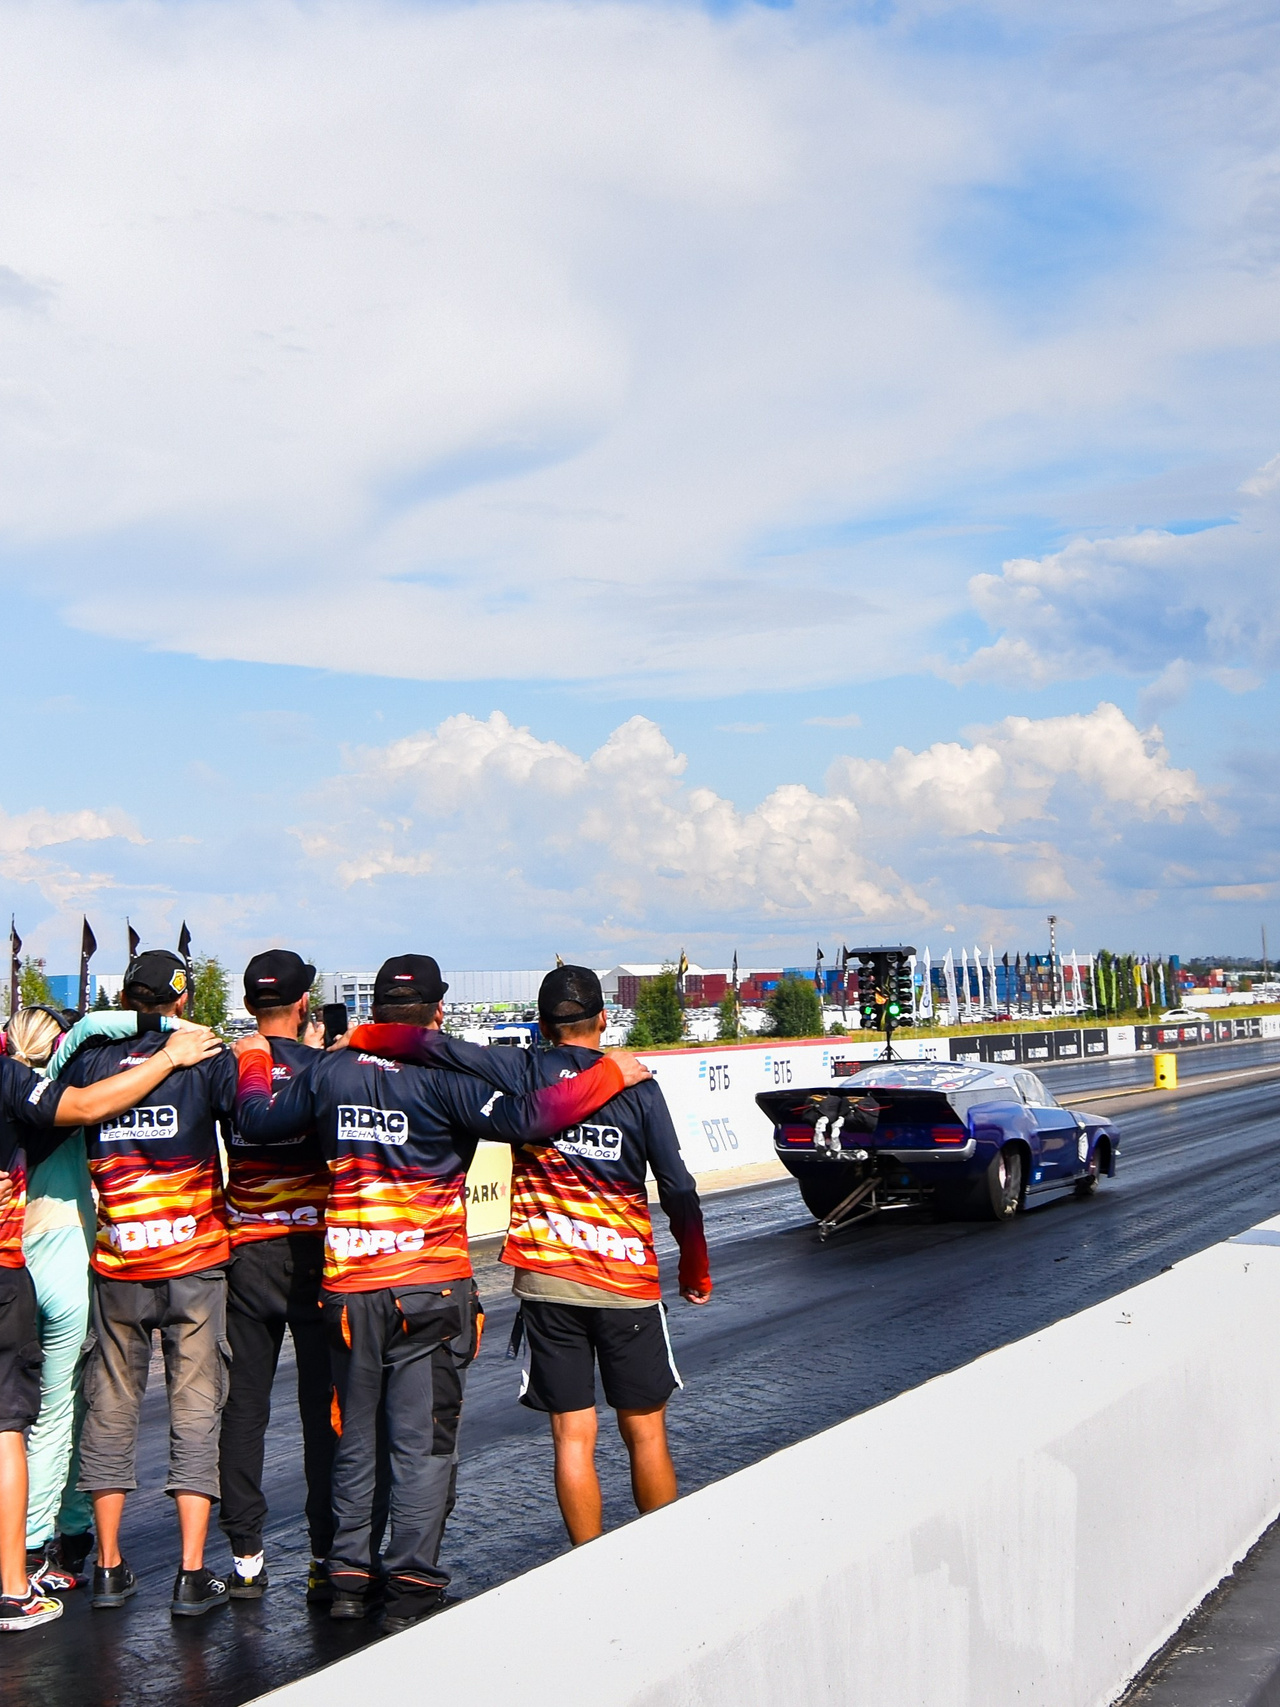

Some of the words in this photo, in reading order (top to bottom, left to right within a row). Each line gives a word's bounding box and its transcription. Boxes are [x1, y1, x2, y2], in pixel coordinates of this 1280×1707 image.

[709, 1065, 730, 1091] ВТБ
[774, 1060, 792, 1084] ВТБ
[340, 1108, 405, 1133] RDRC
[702, 1118, 738, 1152] ВТБ
[556, 1142, 619, 1159] CHNOLOGY
[327, 1227, 424, 1258] RDRC
[546, 1211, 646, 1265] RDRC
